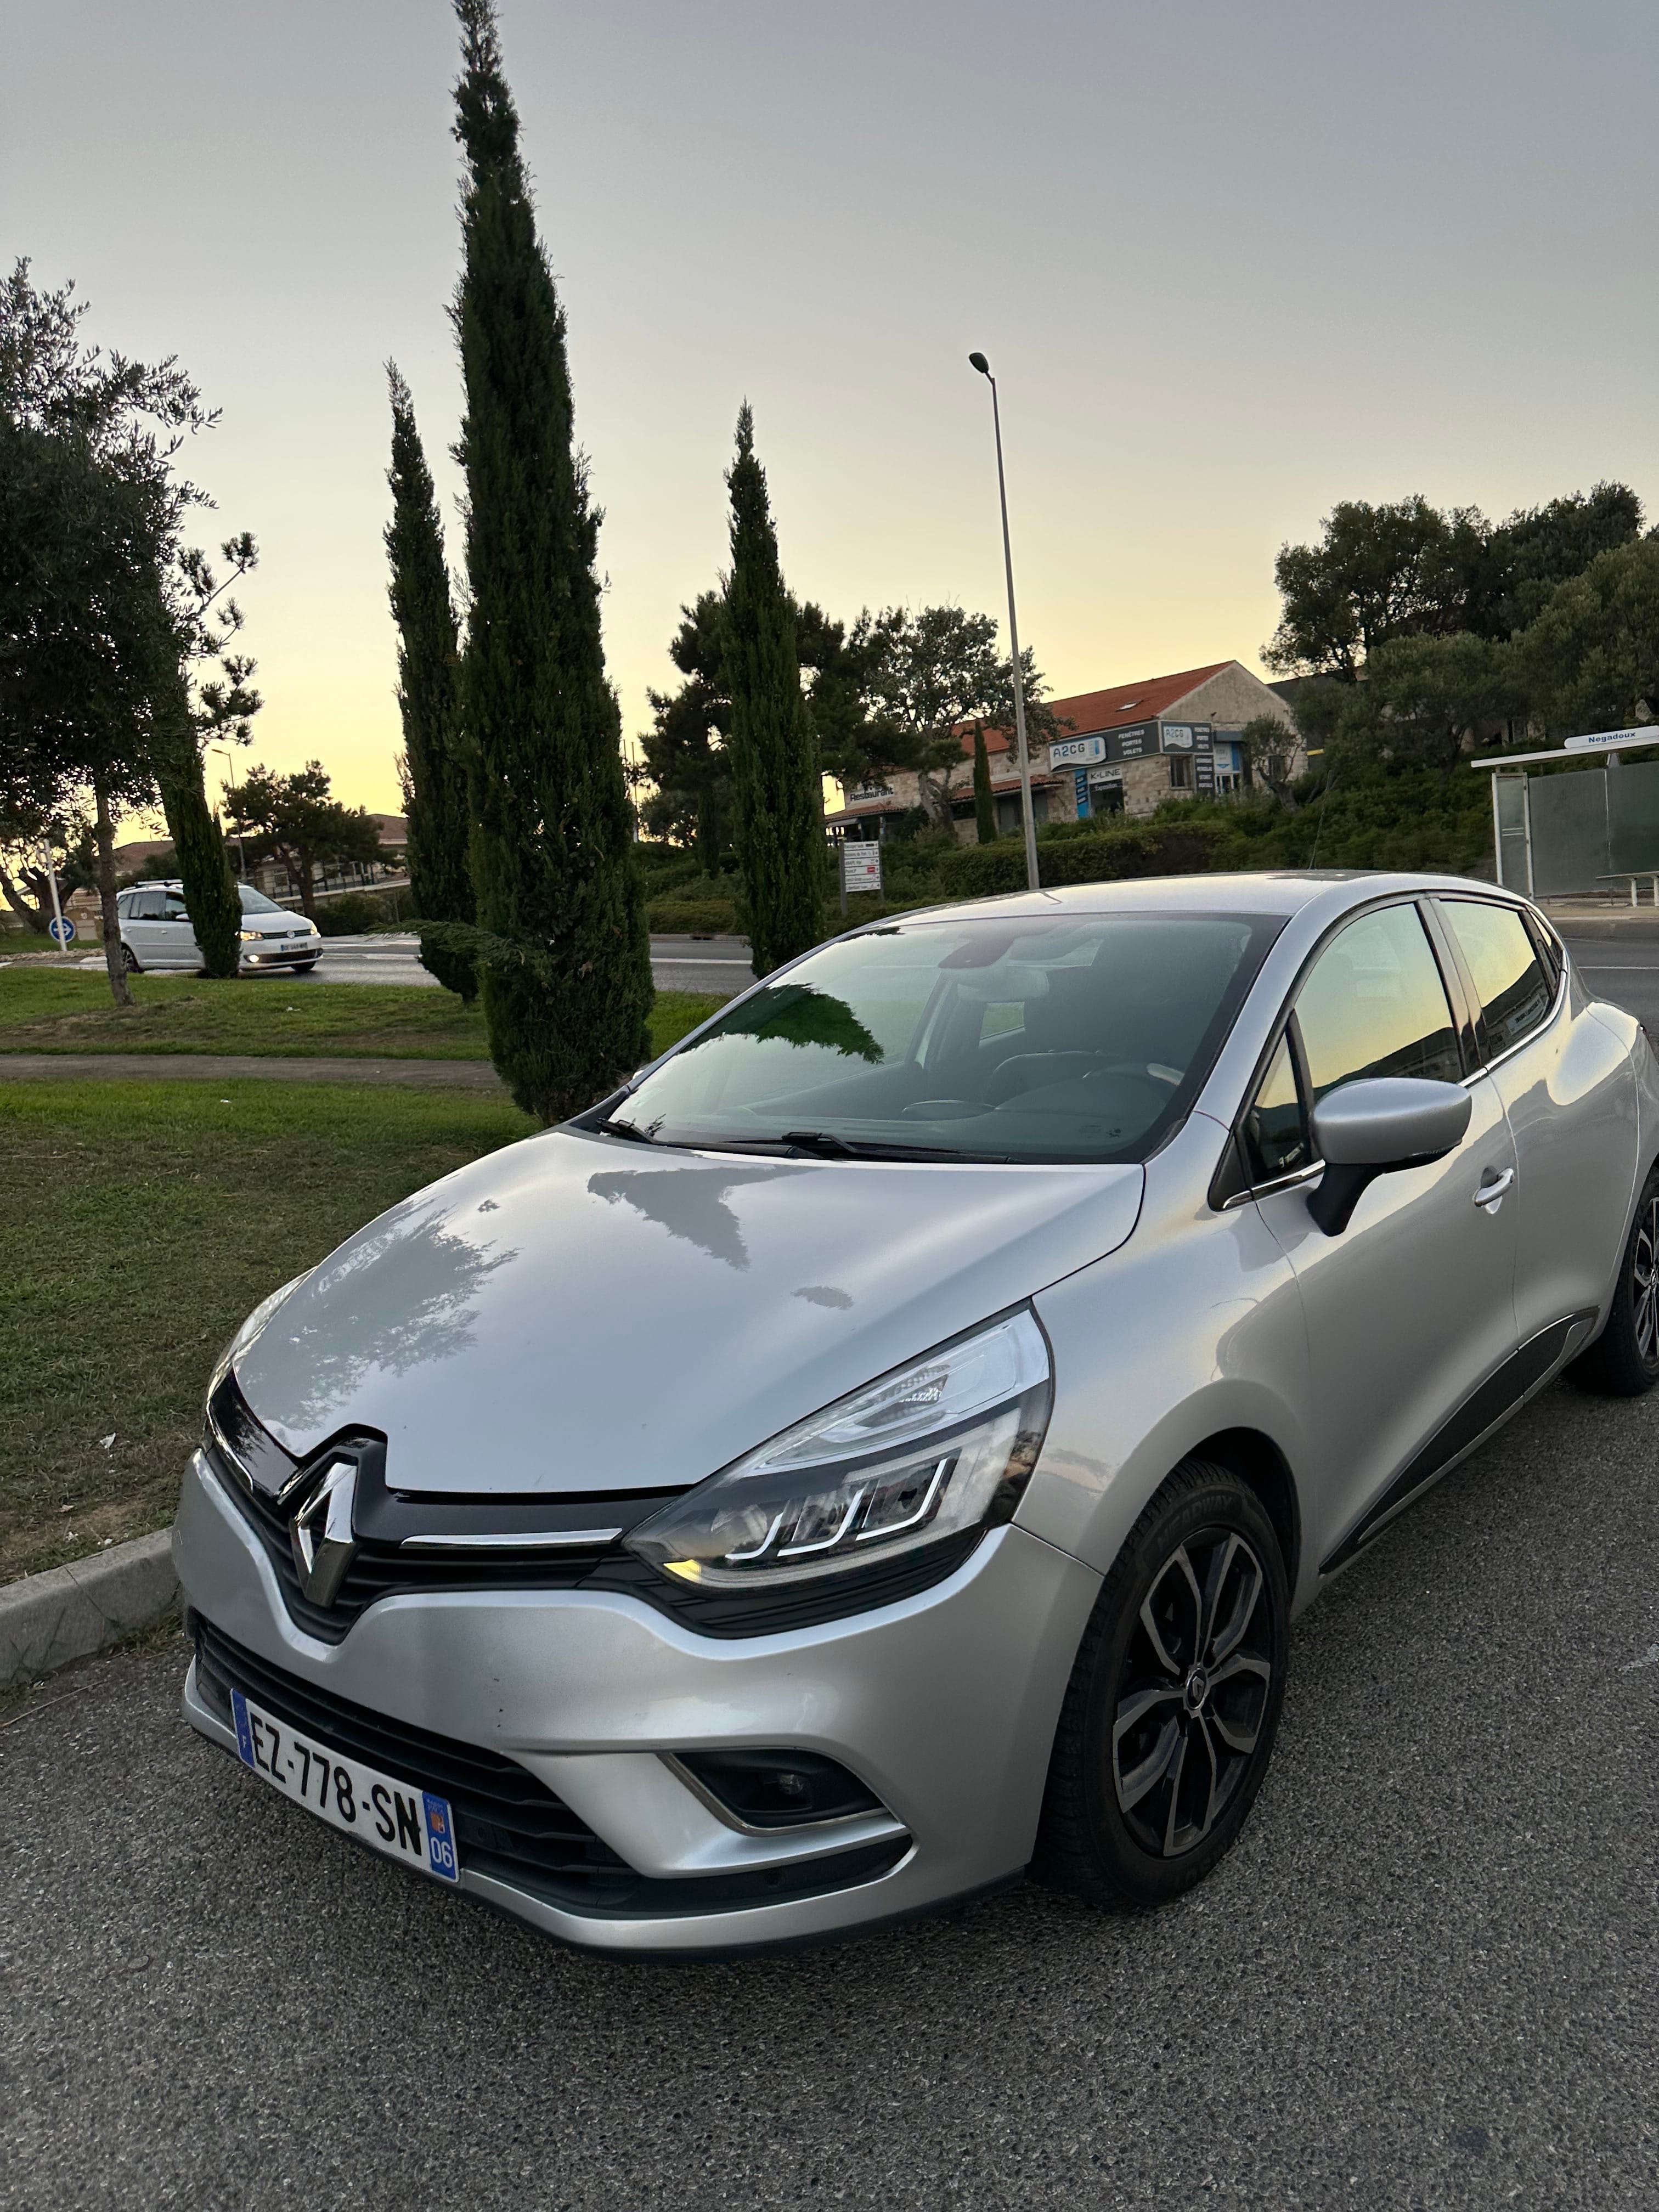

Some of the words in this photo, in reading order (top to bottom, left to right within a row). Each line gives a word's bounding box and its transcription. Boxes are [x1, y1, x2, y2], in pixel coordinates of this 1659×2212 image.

[1588, 732, 1636, 743] Negadoux
[1054, 743, 1085, 758] A2CG
[850, 786, 894, 802] Restaurant
[250, 1711, 422, 1857] EZ-778-SN
[431, 1837, 453, 1869] 06
